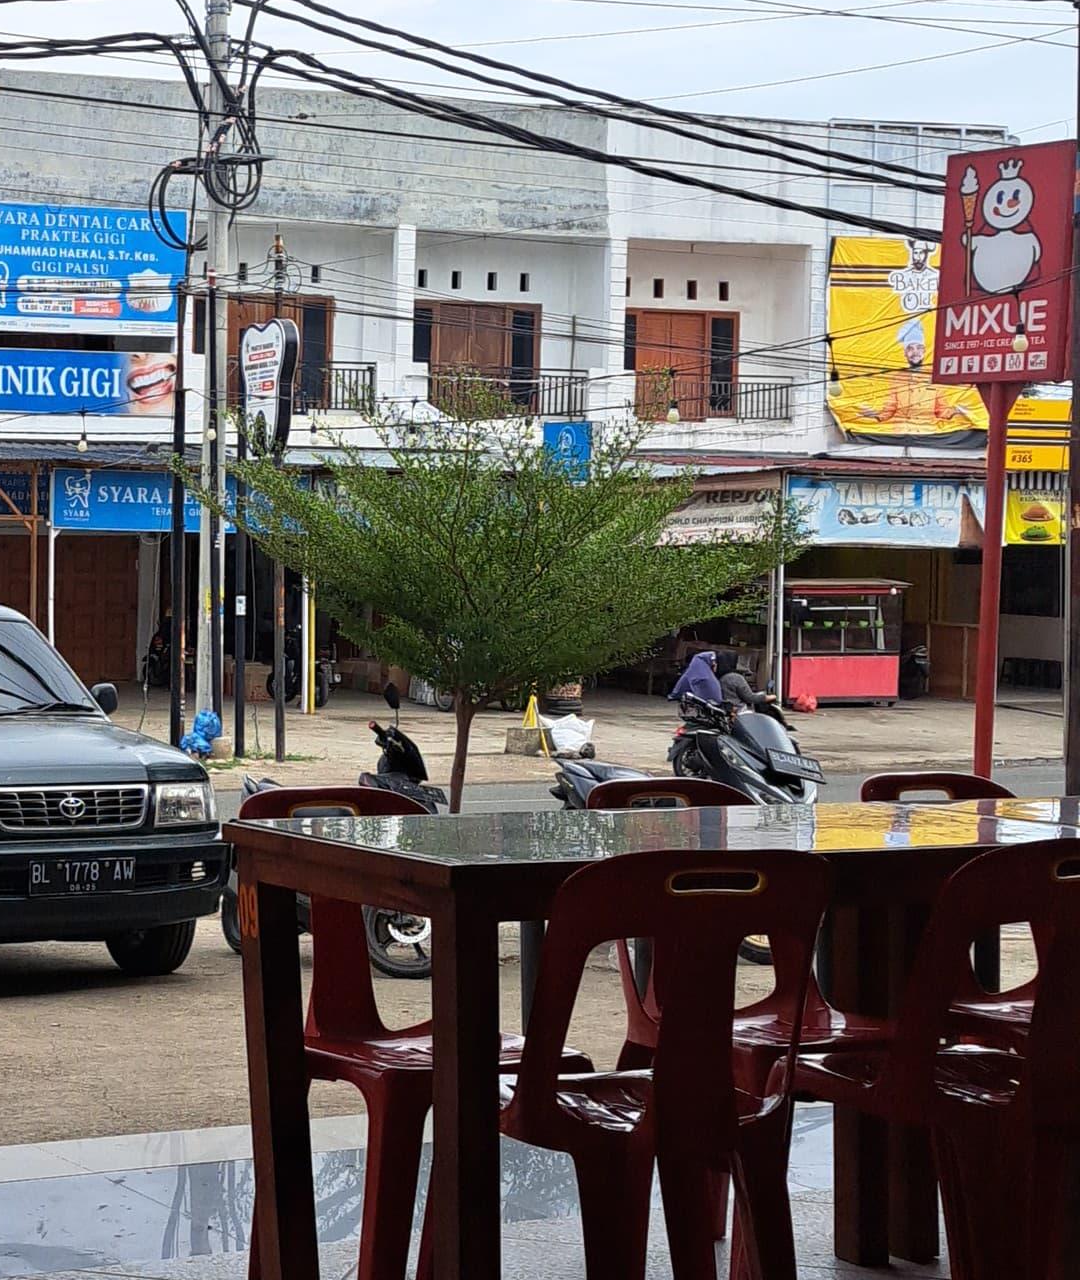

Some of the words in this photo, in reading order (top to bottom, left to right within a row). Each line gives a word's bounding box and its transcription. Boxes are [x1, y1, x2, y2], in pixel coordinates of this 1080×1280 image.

[45, 212, 113, 231] DENTAL
[117, 216, 162, 232] CARE
[21, 228, 90, 244] PRAKTEK
[94, 231, 126, 245] GIGI
[32, 261, 62, 273] GIGI
[65, 262, 109, 275] PALSU
[889, 272, 938, 291] BAKE
[945, 300, 1048, 337] MIXUE
[996, 337, 1015, 347] CREA
[1030, 336, 1046, 345] TEA
[60, 367, 121, 398] GIGI
[1012, 454, 1033, 464] #365
[97, 485, 162, 504] SYARA
[63, 509, 90, 517] SYARA
[32, 863, 50, 884] BL
[65, 861, 99, 882] 1778
[113, 860, 134, 881] AW
